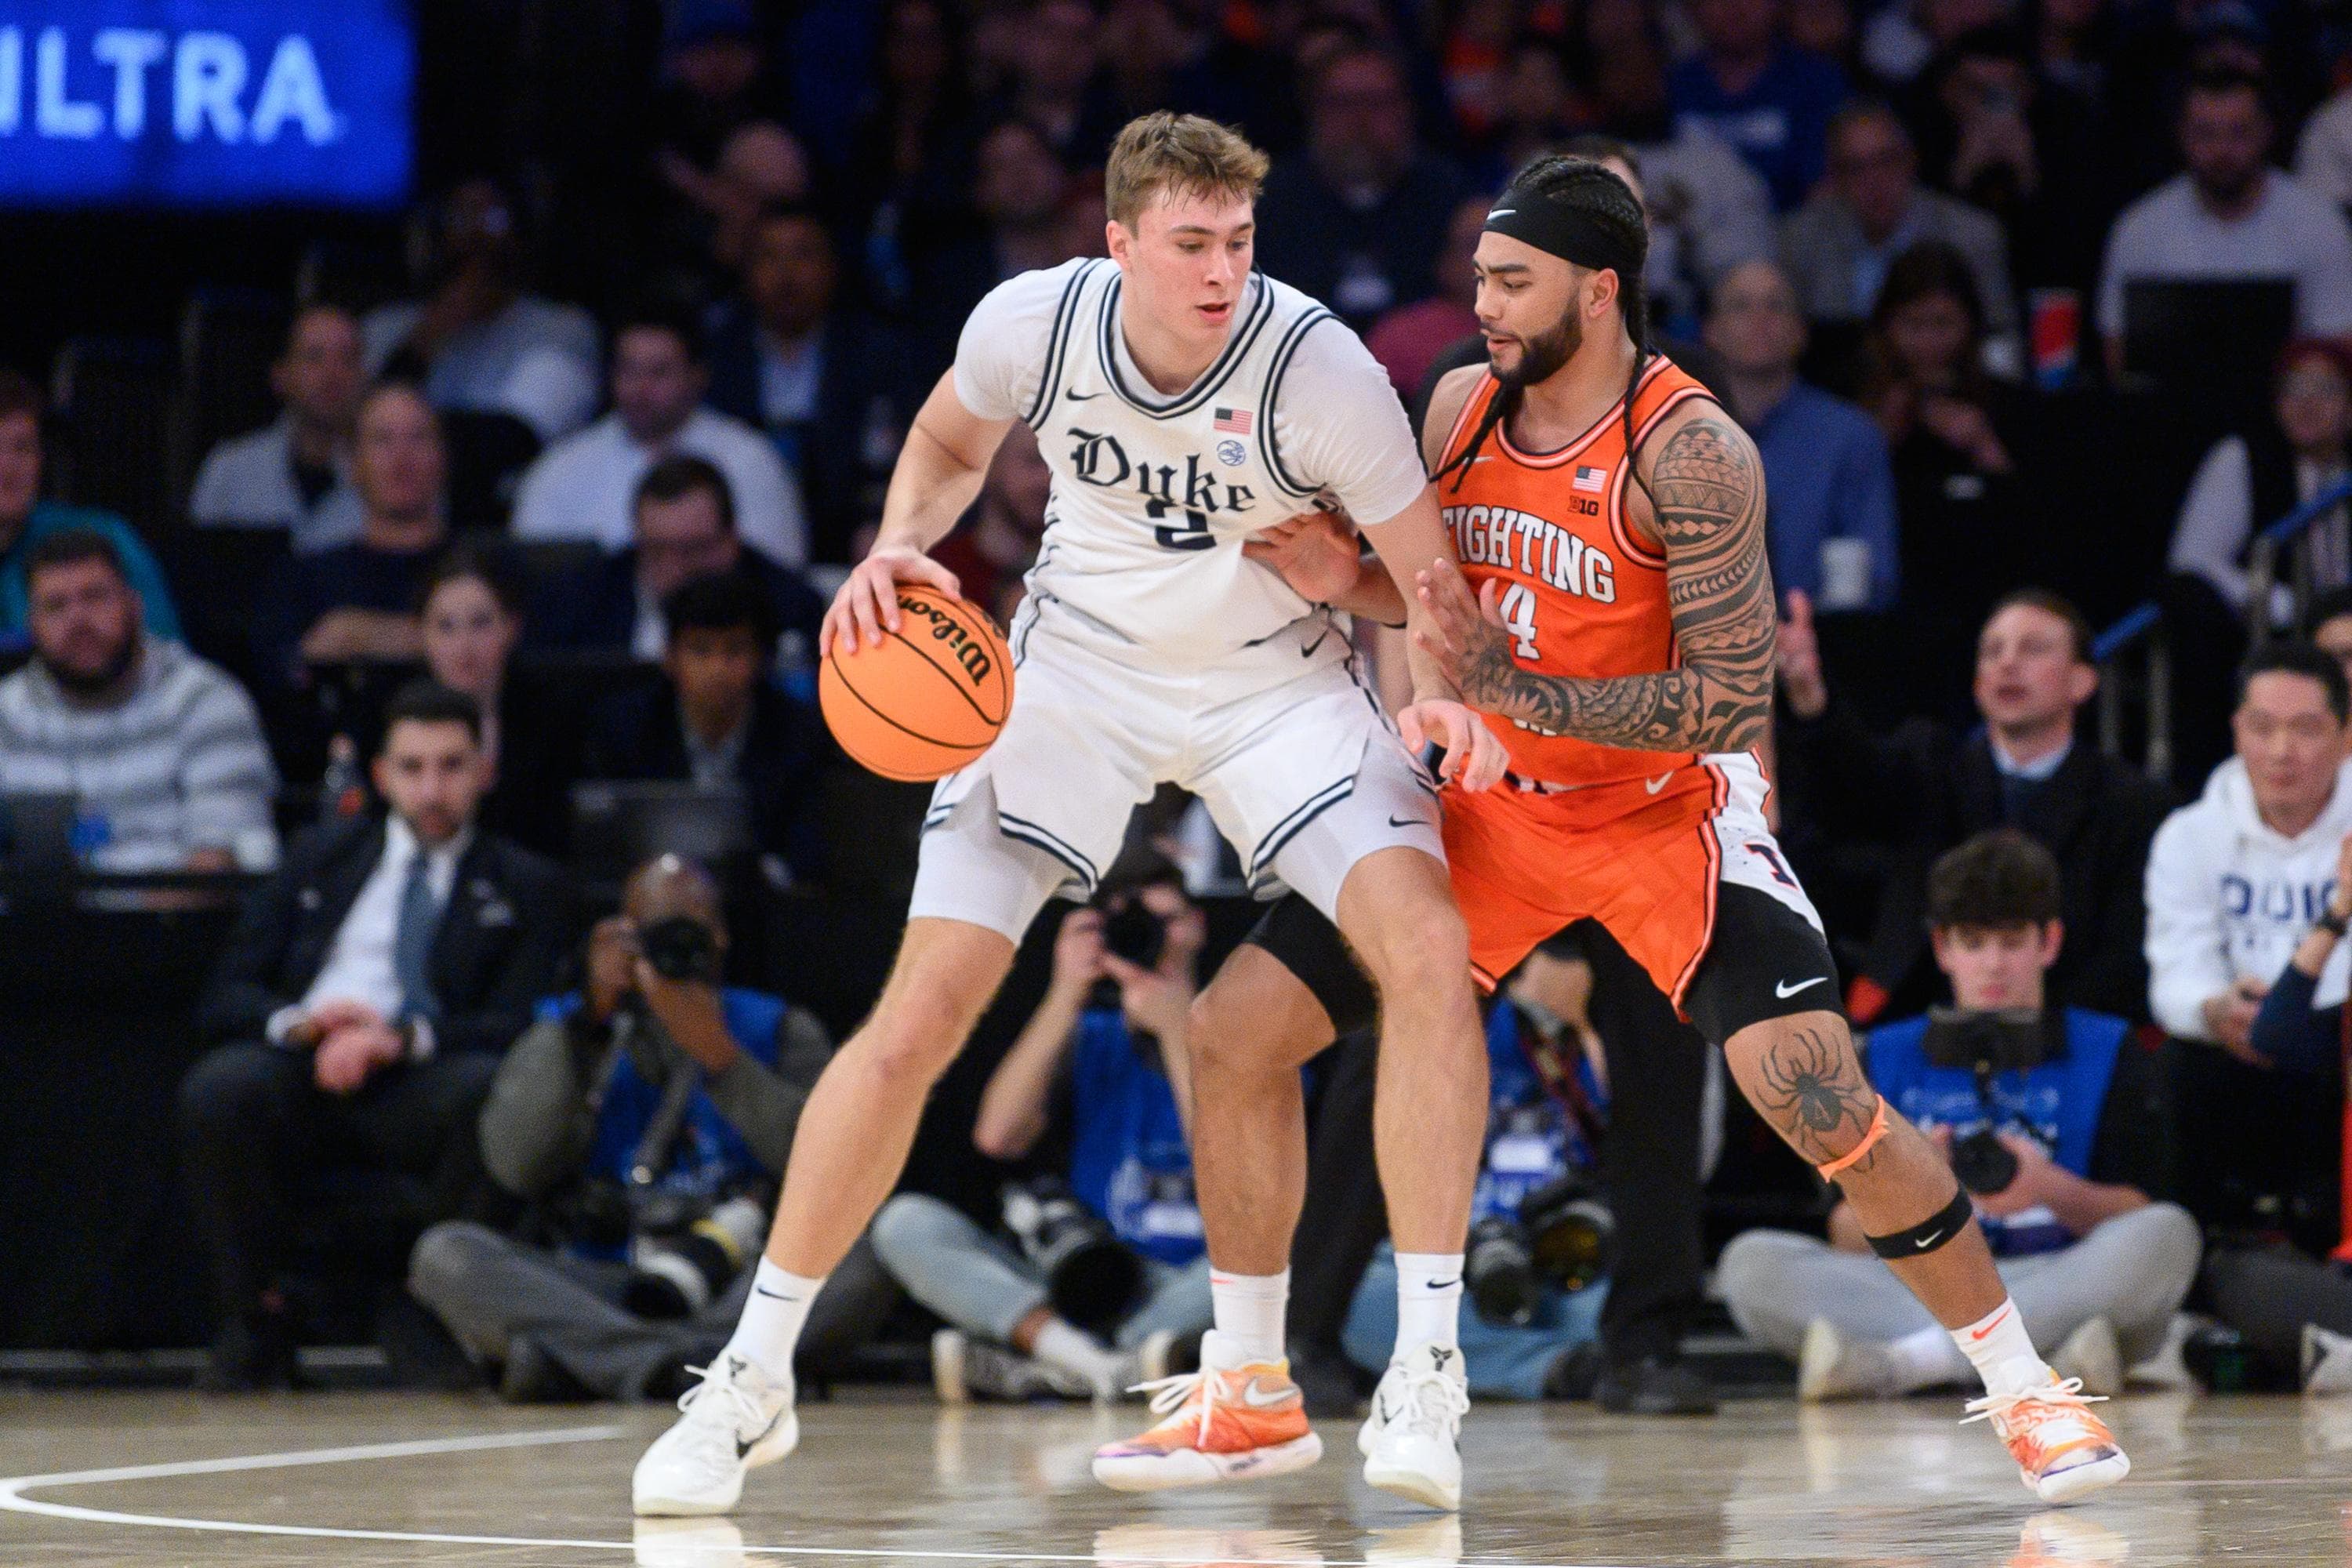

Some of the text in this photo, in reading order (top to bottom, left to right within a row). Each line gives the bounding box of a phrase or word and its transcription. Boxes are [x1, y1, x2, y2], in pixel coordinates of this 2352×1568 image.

[1066, 426, 1256, 512] Duke
[1497, 581, 1541, 660] 4
[2219, 873, 2338, 923] DUK
